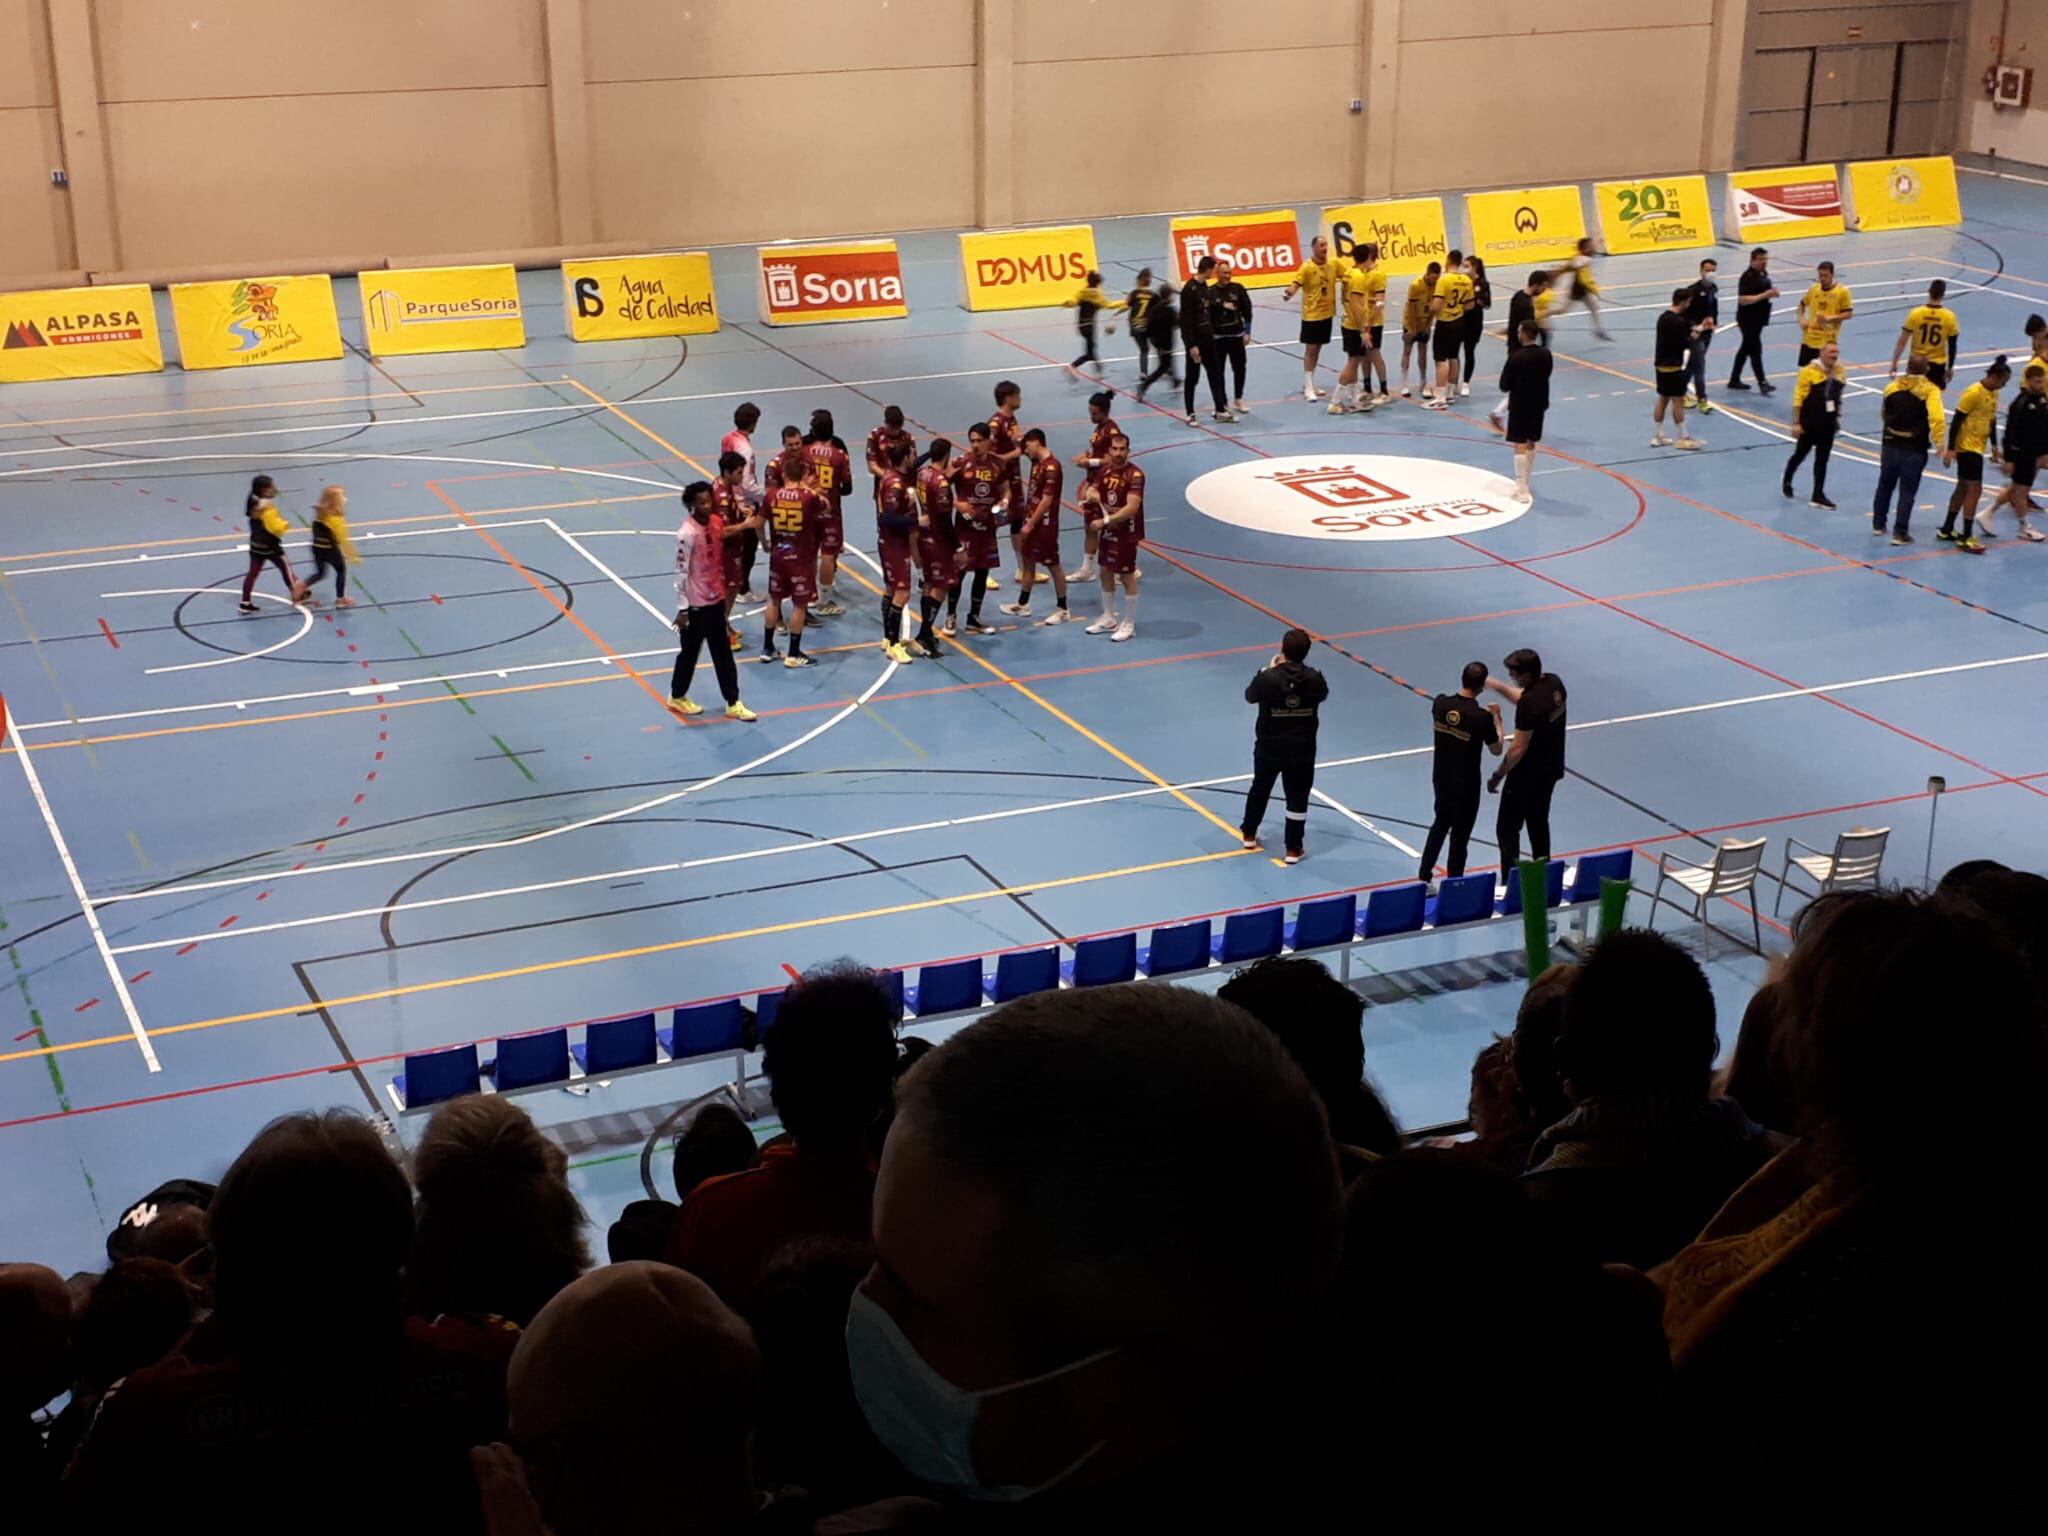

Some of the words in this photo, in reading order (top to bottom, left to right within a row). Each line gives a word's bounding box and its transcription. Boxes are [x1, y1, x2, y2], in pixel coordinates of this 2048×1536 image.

[1616, 185, 1664, 221] 20
[1368, 219, 1407, 246] Agua
[1213, 243, 1295, 270] Soria
[1391, 234, 1446, 259] Calidad
[976, 252, 1087, 287] DOMUS
[619, 275, 664, 304] Agua
[803, 273, 902, 304] Soria
[406, 297, 518, 315] ParqueSoria
[618, 299, 643, 321] de
[646, 293, 714, 320] Calidad
[46, 310, 140, 331] ALPASA
[227, 315, 302, 351] SORIA
[1919, 323, 1943, 347] 16
[975, 469, 992, 481] 42
[772, 508, 803, 532] 22
[1311, 502, 1505, 533] Soria
